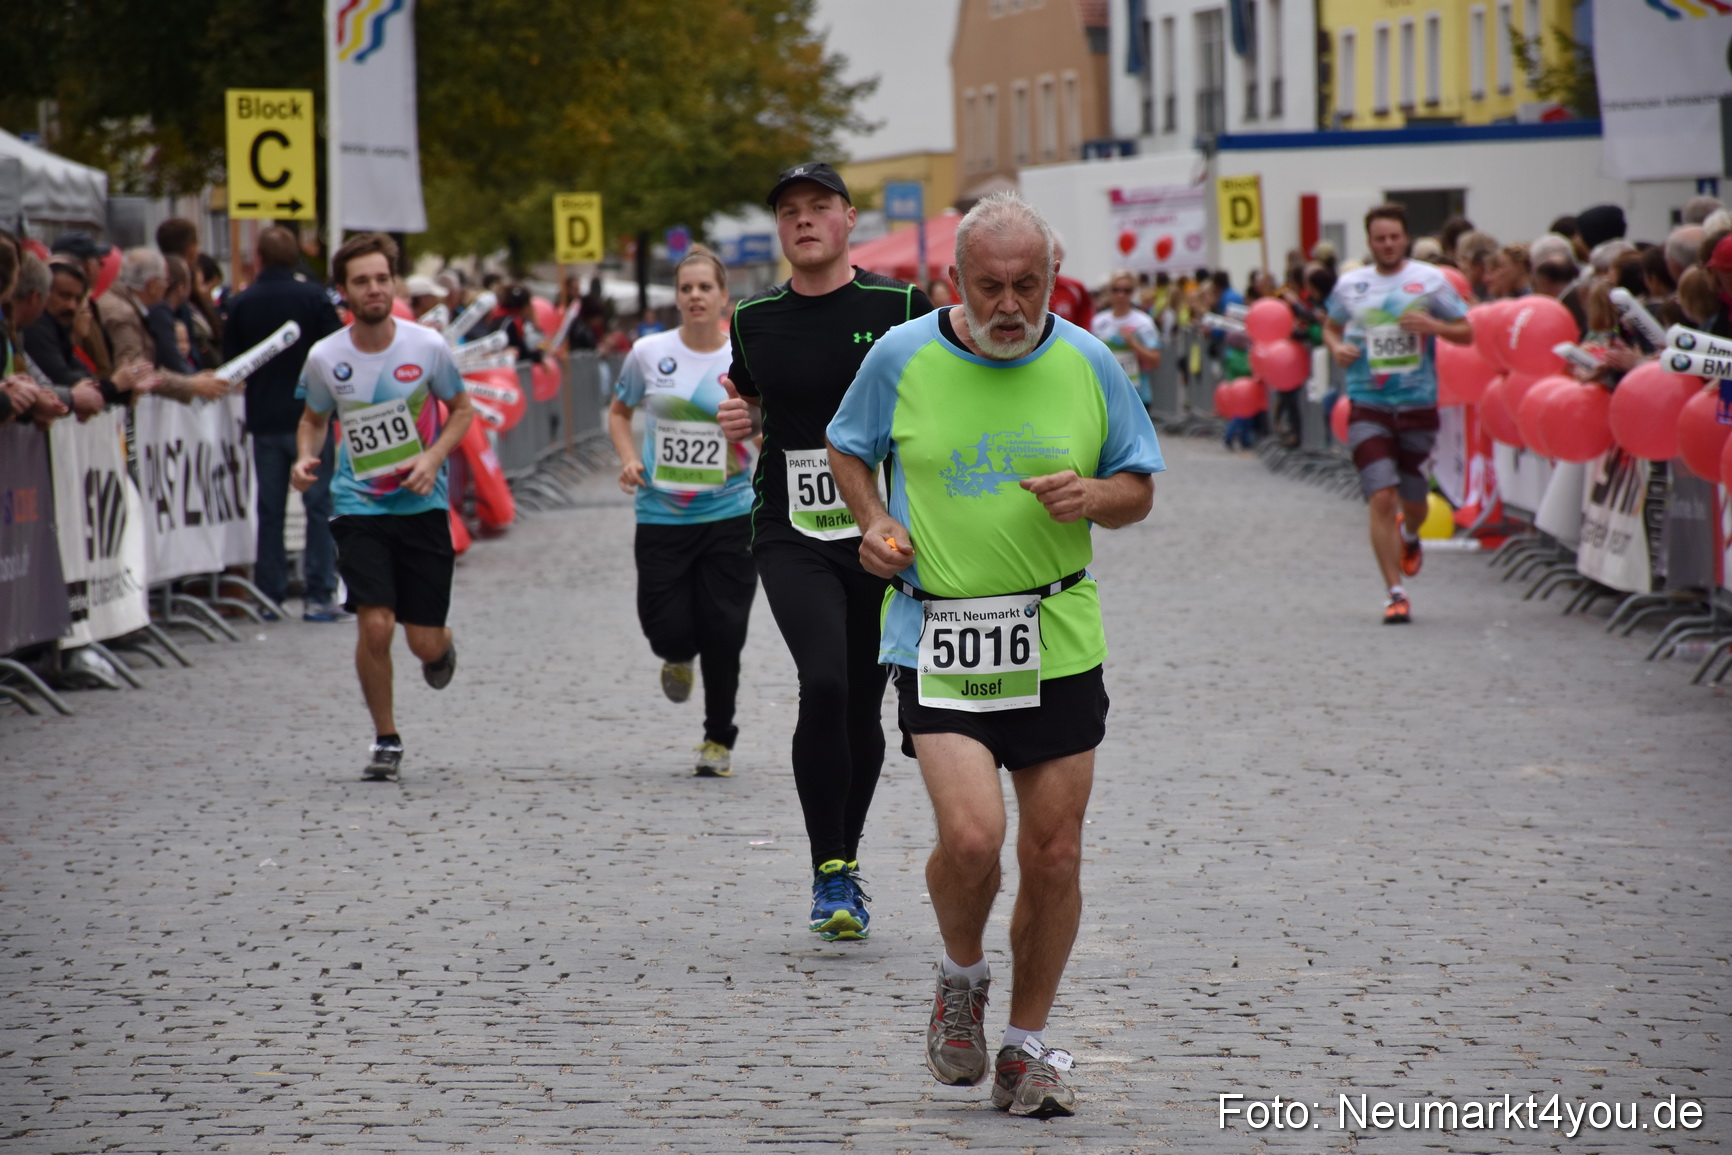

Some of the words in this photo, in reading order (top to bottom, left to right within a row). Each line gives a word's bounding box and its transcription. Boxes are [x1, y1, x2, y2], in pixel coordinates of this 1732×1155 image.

[237, 97, 303, 119] Block
[250, 129, 291, 190] C
[1229, 195, 1254, 228] D
[568, 215, 591, 248] D
[348, 417, 409, 454] 5319
[662, 437, 720, 465] 5322
[789, 460, 817, 468] PARTL
[996, 445, 1070, 456] Frühlingslauf
[798, 472, 839, 506] 50
[927, 611, 961, 622] PARTL
[963, 608, 1020, 621] Neumarkt
[933, 624, 1030, 668] 5016
[923, 665, 929, 673] S
[961, 679, 1002, 696] Josef
